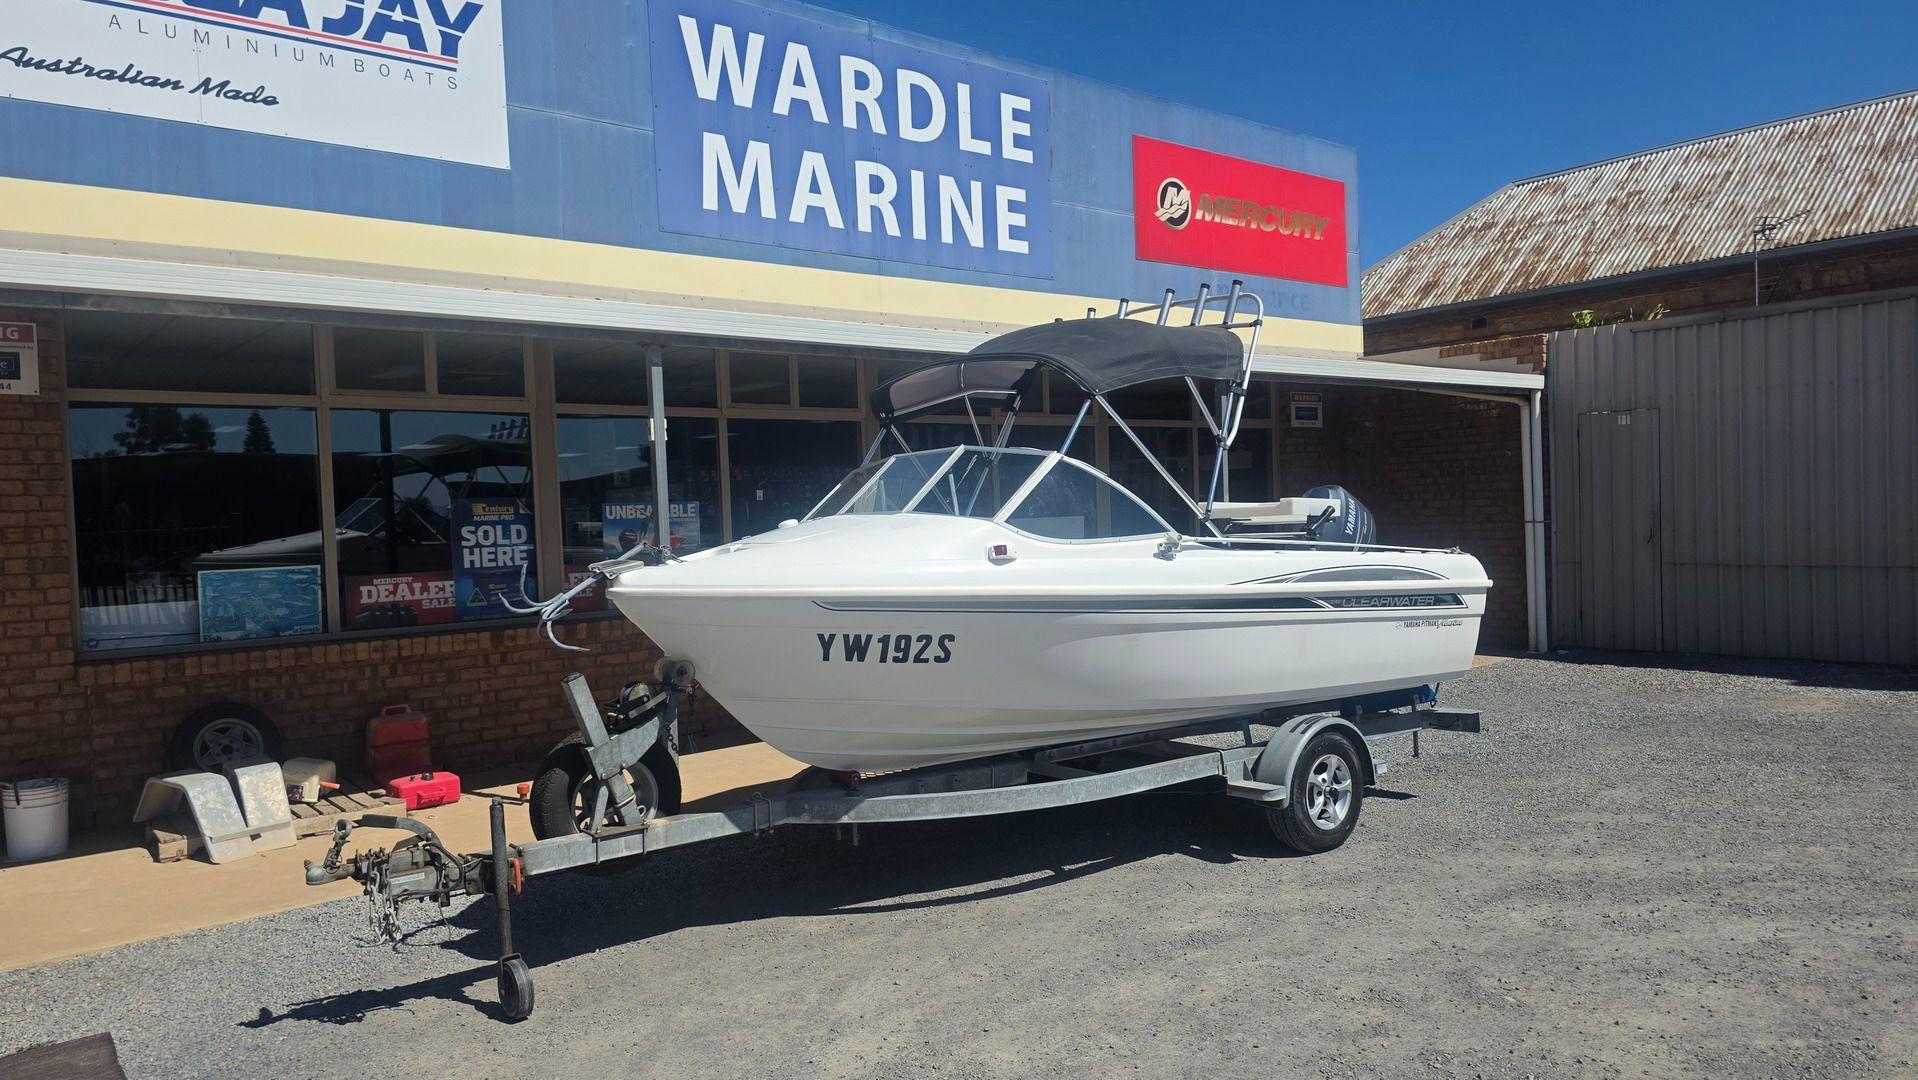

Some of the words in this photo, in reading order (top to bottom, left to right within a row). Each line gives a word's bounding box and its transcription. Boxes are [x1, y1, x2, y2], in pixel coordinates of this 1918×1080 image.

[108, 14, 334, 67] ALUMINIUM
[353, 58, 458, 89] BOATS
[0, 47, 184, 90] Australian
[188, 77, 279, 106] Made
[678, 14, 1033, 163] WARDLE
[702, 131, 1030, 255] MARINE
[1195, 193, 1330, 240] MERCURY
[606, 504, 697, 519] UNBEABLE
[1345, 498, 1356, 536] YAMAHA
[461, 524, 528, 547] SOLD
[463, 546, 528, 568] HERE
[360, 580, 455, 604] DEALER
[373, 577, 413, 585] MERCURY
[422, 598, 456, 609] SALE
[1342, 596, 1435, 607] CLEARWATER
[817, 633, 955, 663] YW192S
